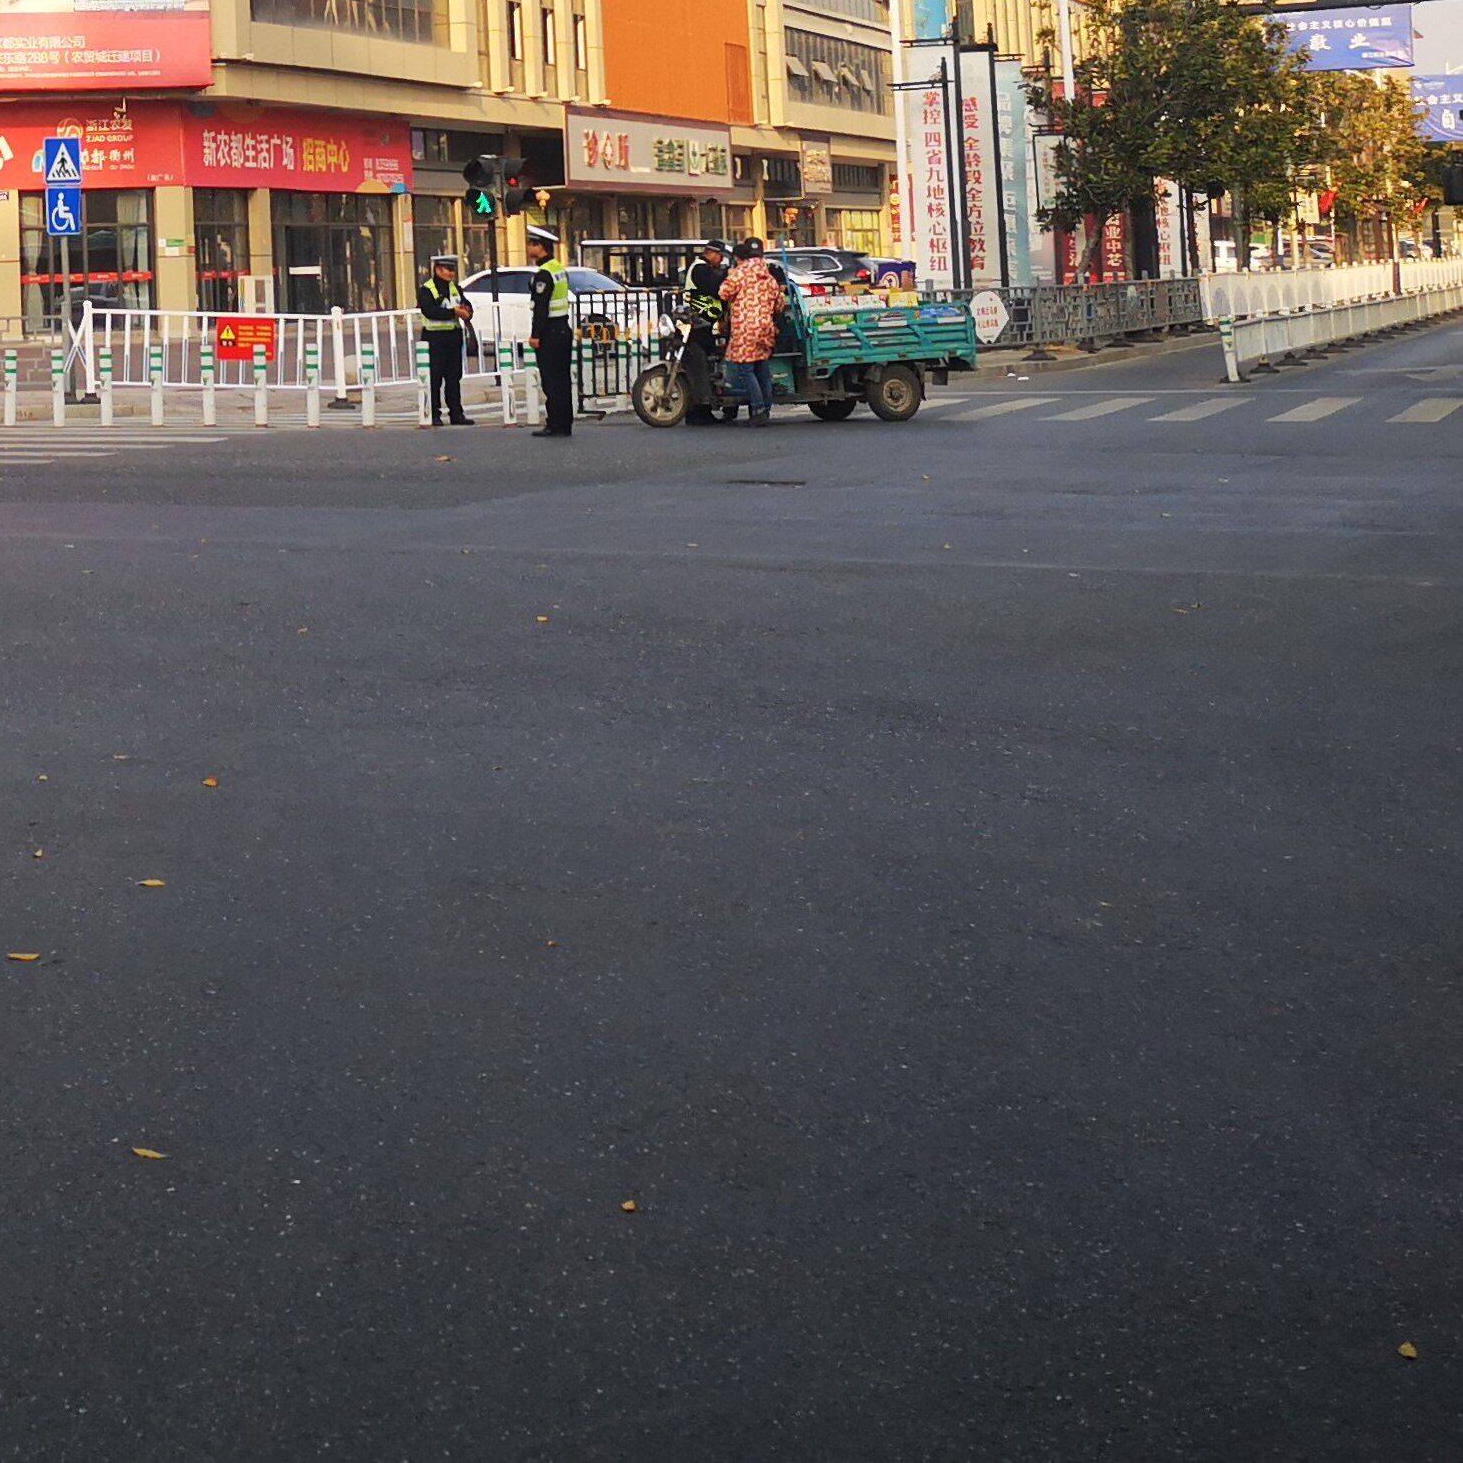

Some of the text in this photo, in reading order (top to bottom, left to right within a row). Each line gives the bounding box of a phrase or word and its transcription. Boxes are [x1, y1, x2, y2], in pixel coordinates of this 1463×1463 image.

[106, 134, 134, 142] GROUP
[203, 130, 296, 170] 新农都生活广场
[301, 138, 351, 173] 招商中心
[922, 91, 949, 272] 掌控 四省九地核心枢纽
